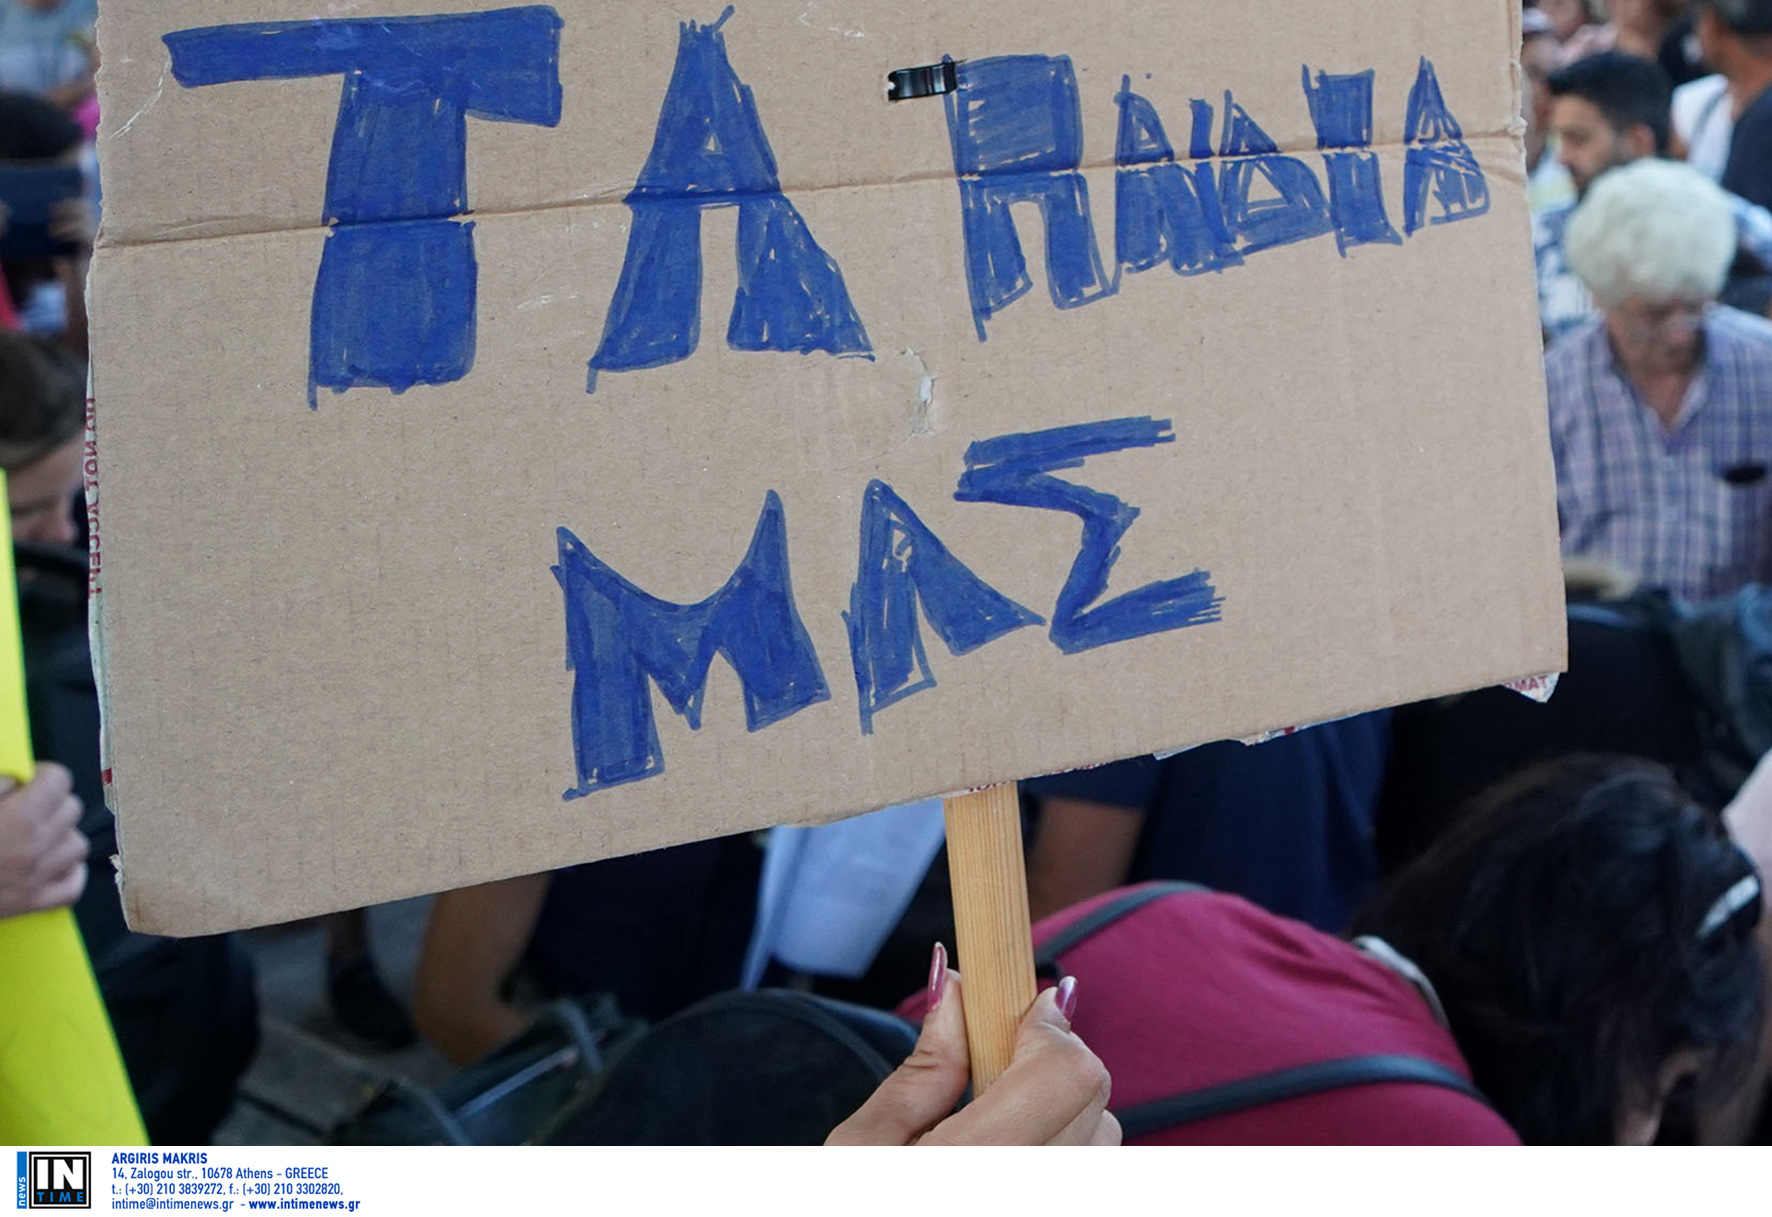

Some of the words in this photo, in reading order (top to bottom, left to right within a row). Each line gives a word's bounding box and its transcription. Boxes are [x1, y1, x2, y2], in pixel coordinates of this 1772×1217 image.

[160, 4, 876, 410] ΤΑ
[942, 53, 1492, 342] ΠΑΙΔΙΑ
[549, 415, 1225, 801] ΜΑΣ
